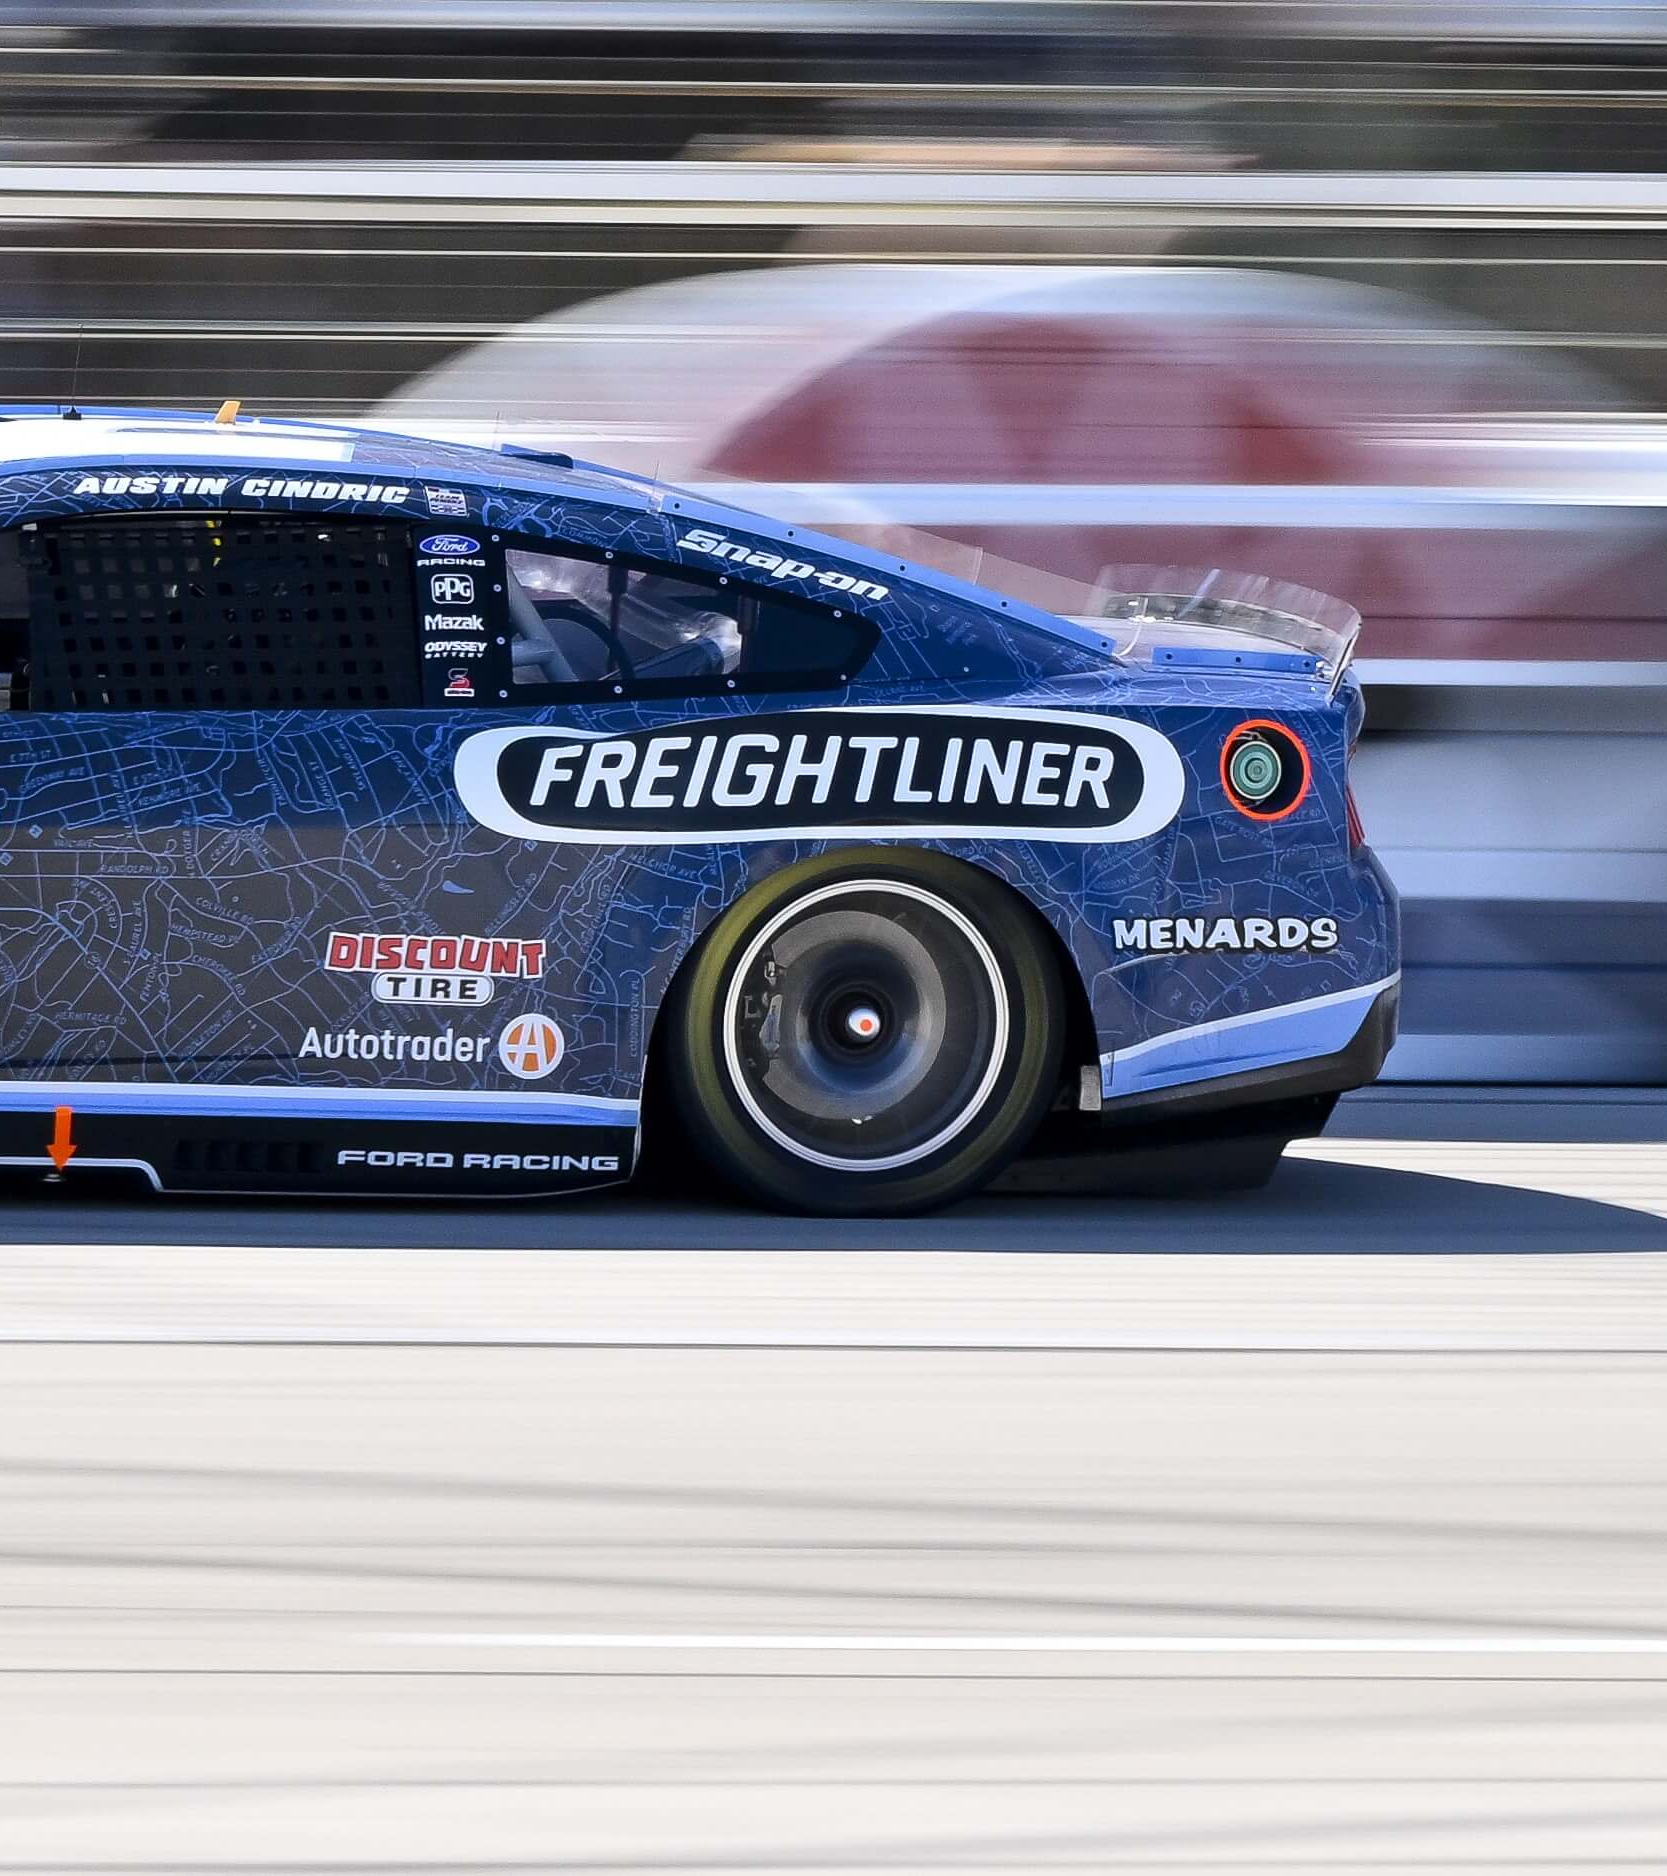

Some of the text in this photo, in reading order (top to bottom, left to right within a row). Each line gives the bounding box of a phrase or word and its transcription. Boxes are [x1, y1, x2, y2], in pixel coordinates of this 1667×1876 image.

[74, 477, 410, 505] AUSTIN CINDRIC
[432, 538, 469, 552] Ford
[416, 558, 486, 567] RACING
[676, 528, 889, 601] Snap-on
[434, 577, 471, 601] PPG
[424, 613, 485, 631] Mazak
[424, 640, 488, 652] ODYSSEY
[529, 733, 1115, 809] FREIGHTLINER
[1112, 917, 1339, 950] MENARDS
[326, 933, 545, 977] DISCOUNT
[387, 976, 479, 1000] TIRE
[298, 1026, 490, 1063] Autotrader
[337, 1149, 619, 1171] FORD RACING
